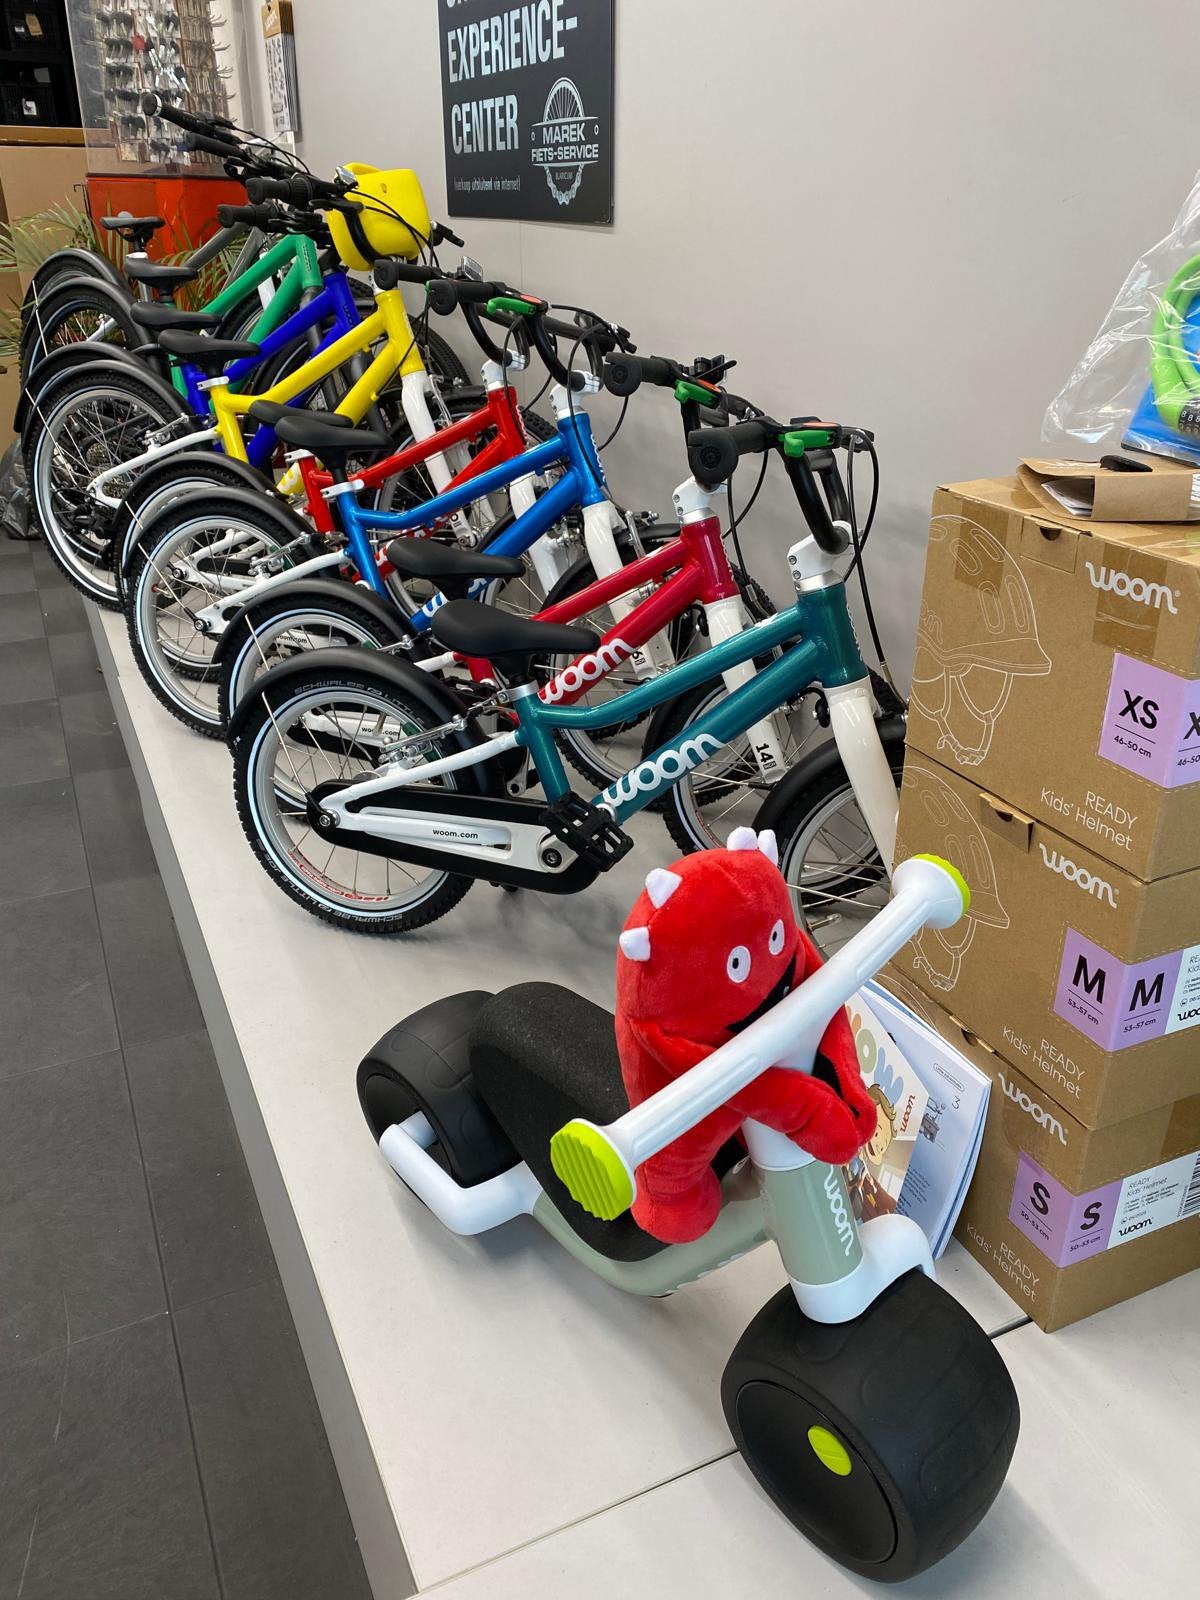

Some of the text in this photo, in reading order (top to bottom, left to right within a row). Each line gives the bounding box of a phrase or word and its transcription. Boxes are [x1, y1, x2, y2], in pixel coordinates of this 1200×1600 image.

[447, 0, 578, 83] EXPERIENCE-
[451, 94, 519, 154] CENTER
[542, 122, 586, 145] MAREK
[531, 144, 599, 162] FIETS-SERVICE
[1085, 561, 1178, 614] woom
[293, 680, 365, 695] SCHWALBE
[538, 638, 639, 704] woom
[1118, 689, 1159, 729] XS
[361, 726, 400, 737] wo.com
[602, 733, 728, 807] woom
[755, 742, 774, 763] 14
[1139, 747, 1152, 758] cm
[1075, 809, 1133, 851] Helmet
[1085, 790, 1138, 830] READY
[432, 828, 479, 840] woom.com
[281, 875, 318, 909] LITTLE
[1039, 843, 1117, 908] woom
[332, 909, 403, 923] SCHWALBE
[1072, 954, 1106, 1004] M
[1129, 972, 1165, 1012] M
[1088, 1013, 1099, 1025] cm
[1145, 1018, 1156, 1026] cm
[1032, 1051, 1081, 1099] Helmet
[1040, 1039, 1085, 1081] READY
[899, 1094, 916, 1134] woom
[998, 1073, 1067, 1146] woom
[823, 1164, 854, 1257] woom
[1030, 1182, 1051, 1217] S
[1080, 1202, 1101, 1232] S
[1038, 1227, 1050, 1241] cm
[1089, 1236, 1101, 1245] cm
[1118, 1218, 1152, 1237] woom
[993, 1253, 1036, 1302] Helmet
[1000, 1241, 1040, 1287] READY
